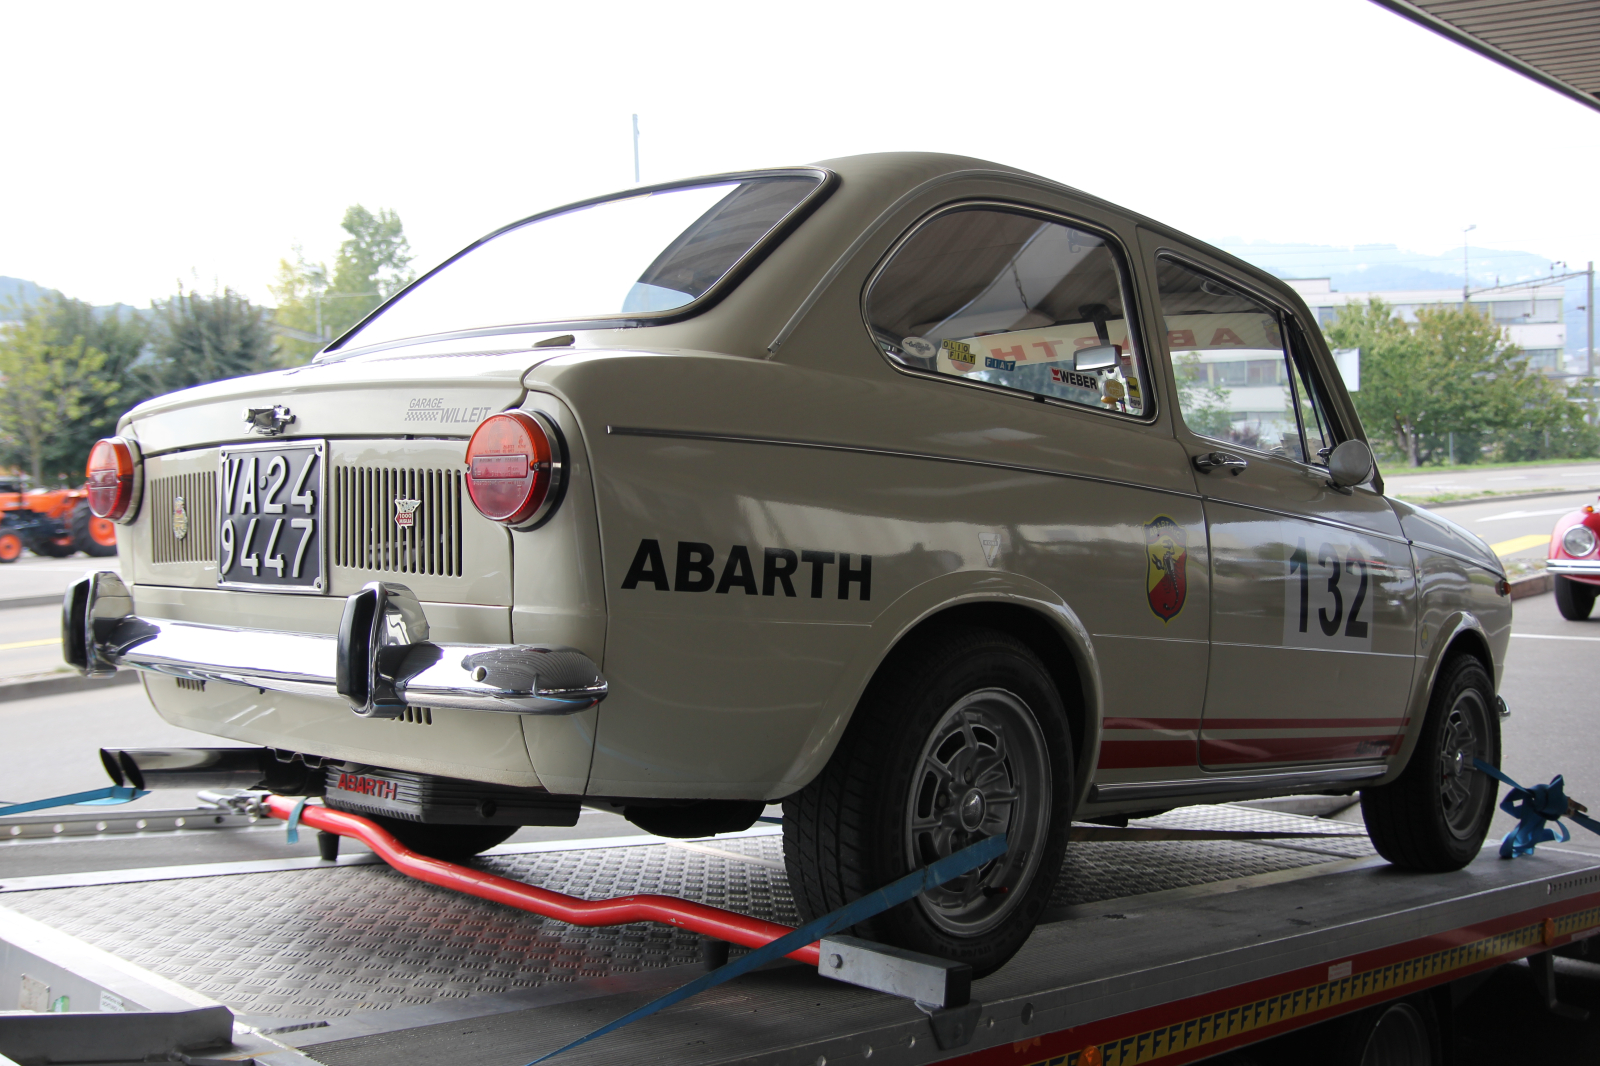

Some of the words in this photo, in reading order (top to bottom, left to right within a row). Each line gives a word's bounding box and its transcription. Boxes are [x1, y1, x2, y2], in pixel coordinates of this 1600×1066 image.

[943, 341, 968, 352] OLIO
[950, 351, 974, 363] FIAT
[986, 358, 1014, 370] FIAT
[1059, 370, 1098, 389] WEBER
[409, 398, 444, 408] GARAGE
[440, 407, 491, 423] WILLEIT
[221, 518, 314, 578] 9447
[620, 538, 873, 602] ABARTH
[1289, 536, 1369, 638] 132
[337, 773, 397, 800] ABARTH
